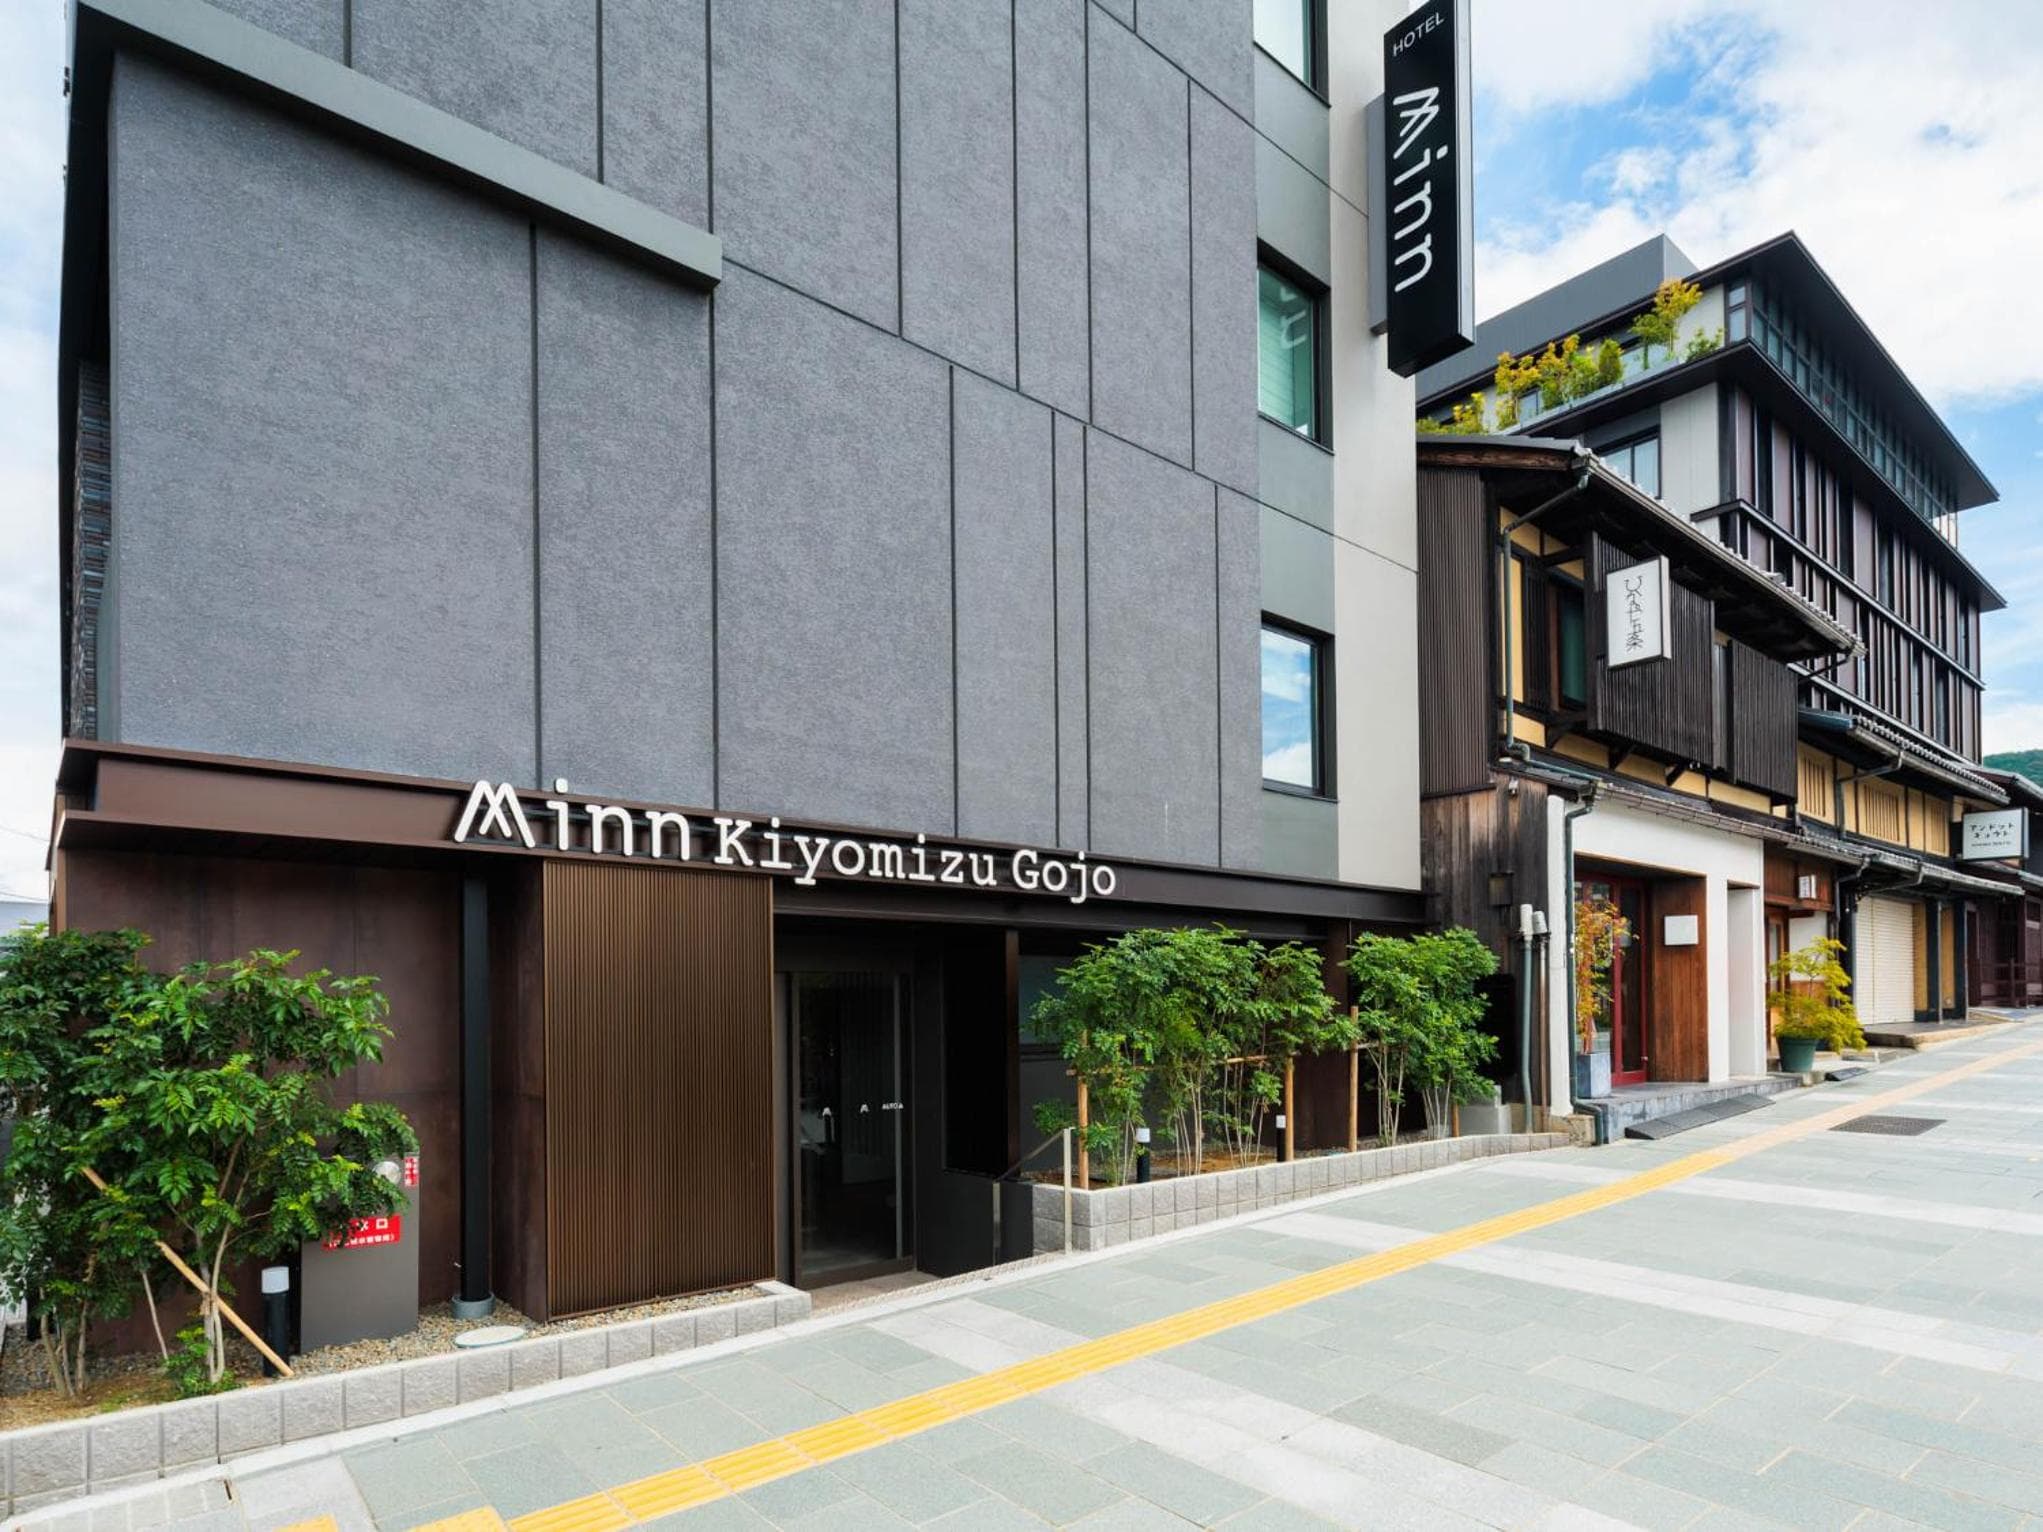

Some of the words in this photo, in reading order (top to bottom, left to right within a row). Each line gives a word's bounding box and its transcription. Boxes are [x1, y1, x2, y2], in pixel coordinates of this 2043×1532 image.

[1392, 12, 1445, 57] HOTEL
[1392, 86, 1448, 293] Minn
[453, 777, 691, 862] Minn
[713, 817, 998, 889] Kiyomizu
[1012, 849, 1117, 904] Gojo
